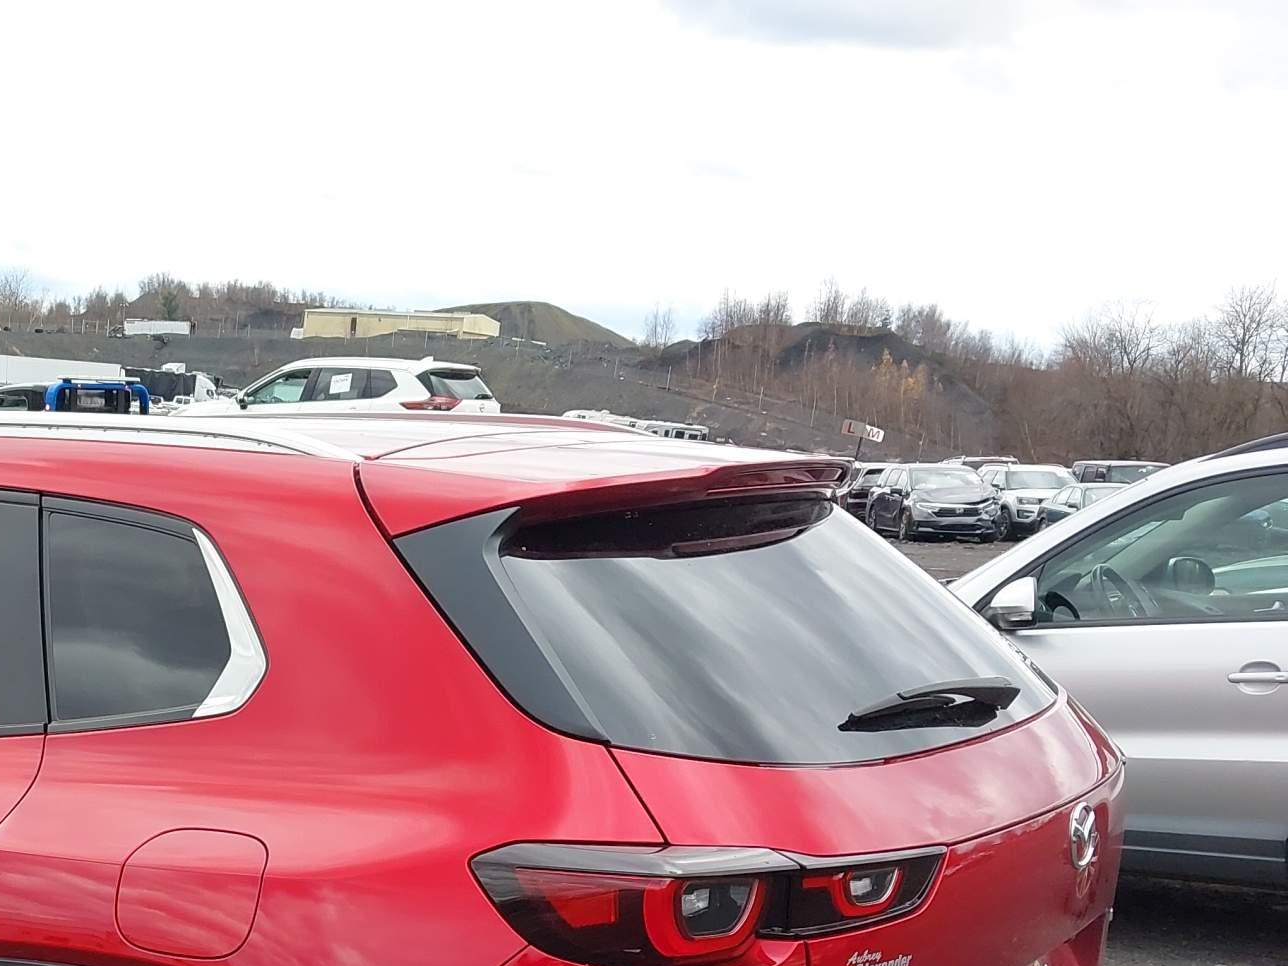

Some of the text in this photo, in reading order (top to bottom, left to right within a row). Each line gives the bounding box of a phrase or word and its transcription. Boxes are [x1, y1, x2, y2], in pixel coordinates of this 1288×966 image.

[847, 421, 855, 433] L
[867, 428, 881, 440] M
[846, 949, 882, 966] Aubrey
